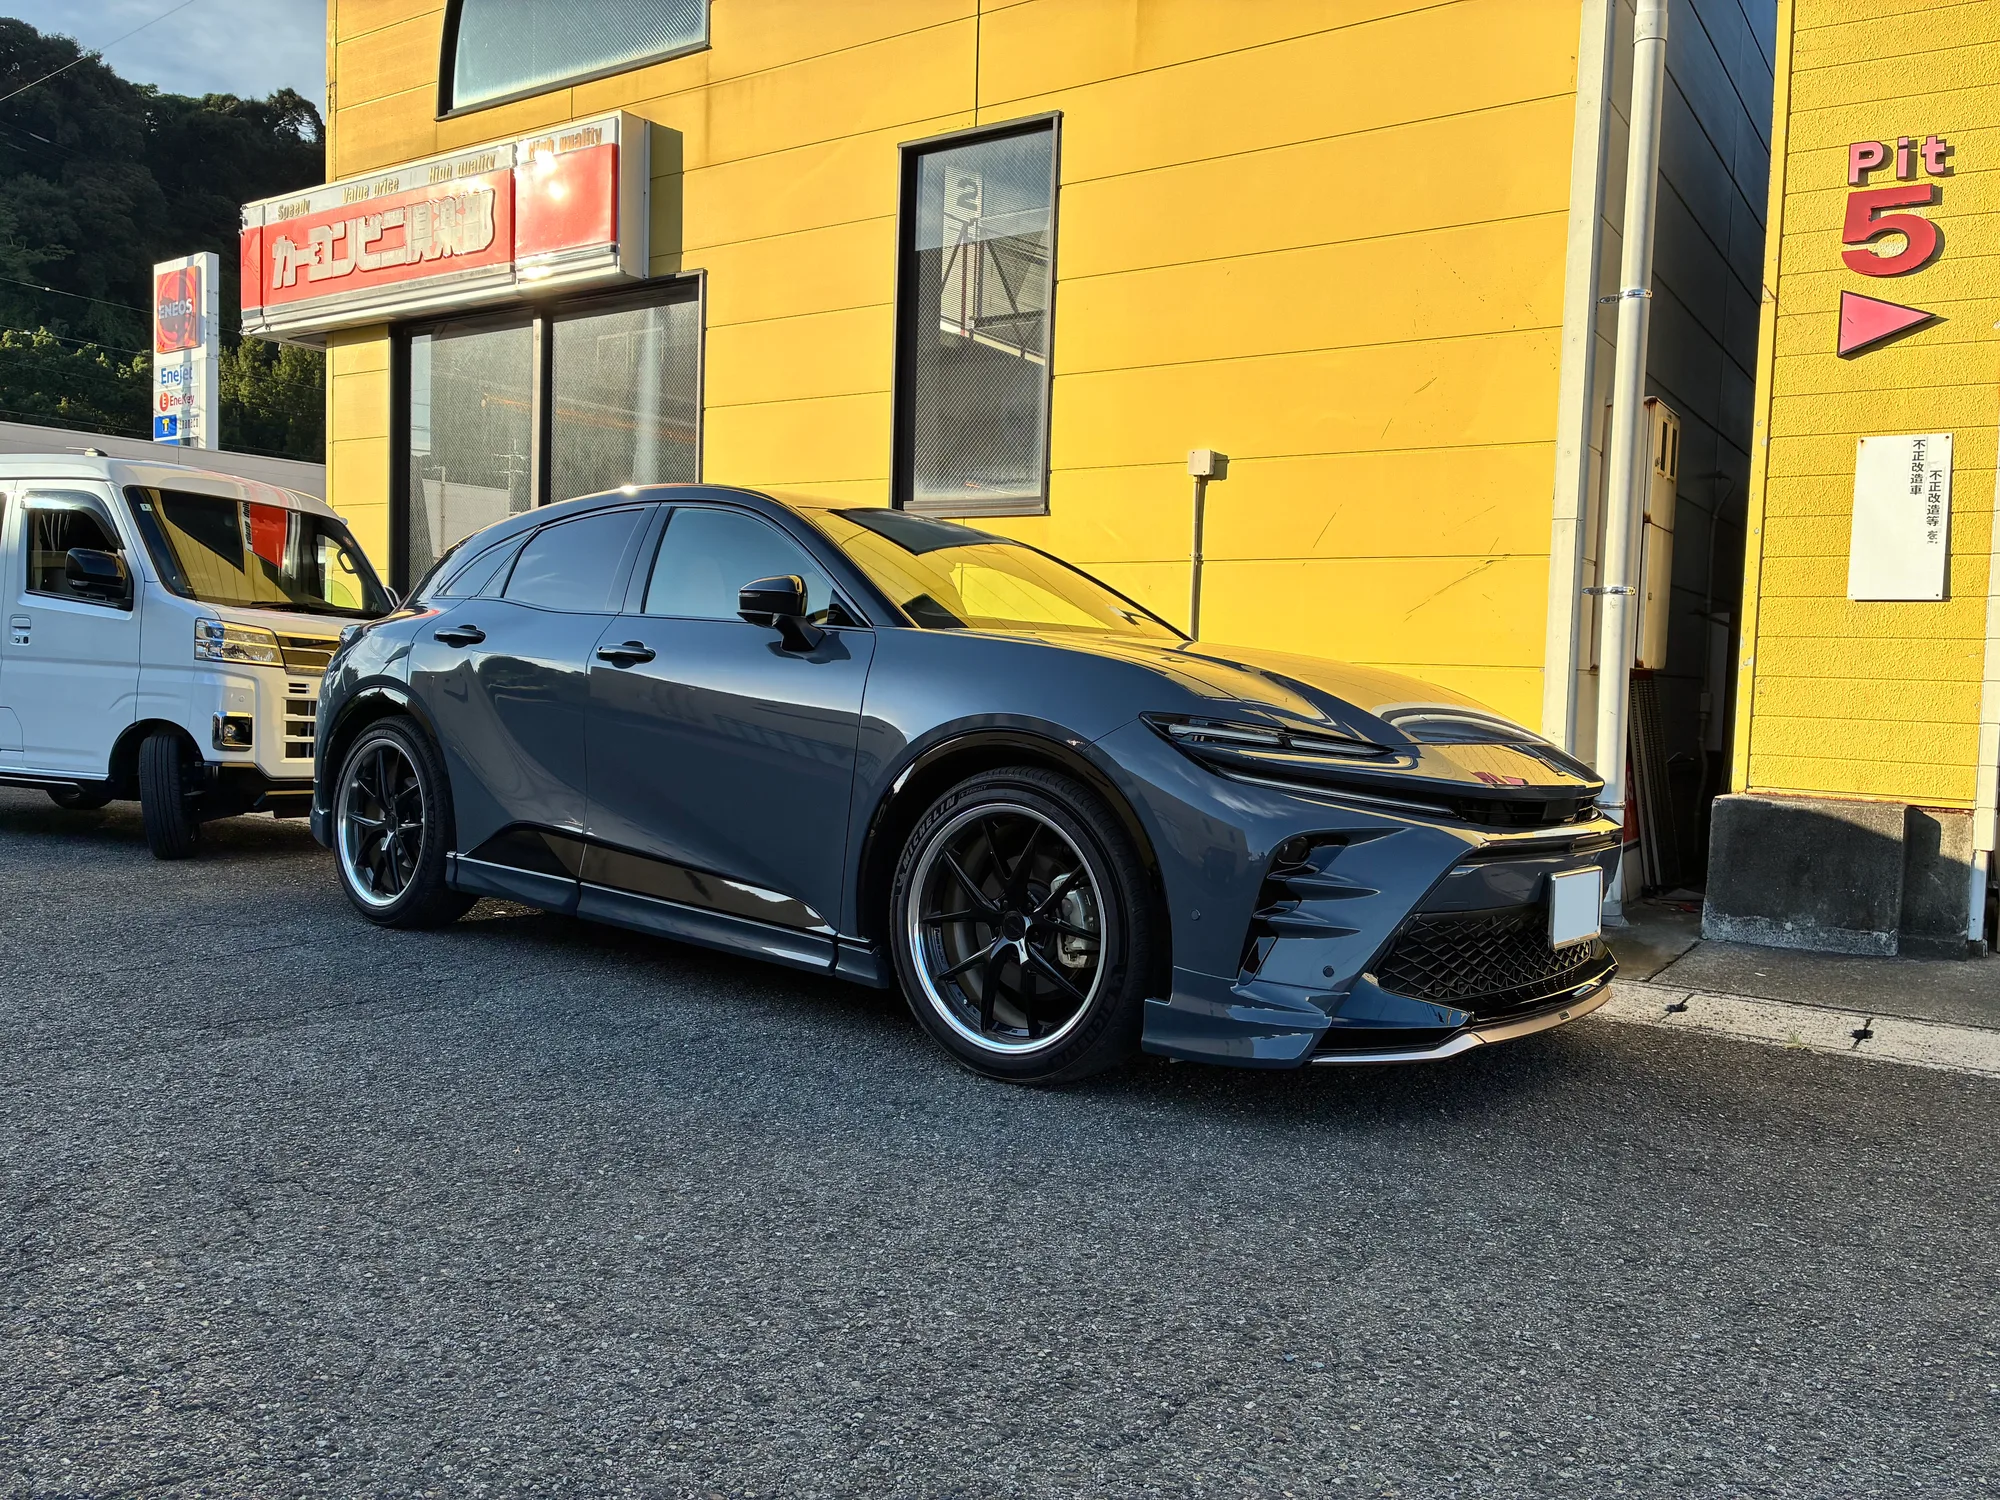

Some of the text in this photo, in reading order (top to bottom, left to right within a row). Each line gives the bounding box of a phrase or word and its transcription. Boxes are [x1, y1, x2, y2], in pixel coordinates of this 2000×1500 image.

[559, 128, 602, 154] quality
[1848, 136, 1946, 186] Pit
[278, 154, 496, 220] Speedy Value price High quality
[1841, 183, 1933, 276] 5
[158, 298, 192, 319] ENEOS
[161, 364, 192, 385] EneJet
[169, 394, 194, 406] EneKey
[1910, 439, 1926, 495] 不正改造車
[1926, 470, 1943, 544] 不正改造等を
[903, 795, 956, 869] MICHELIN
